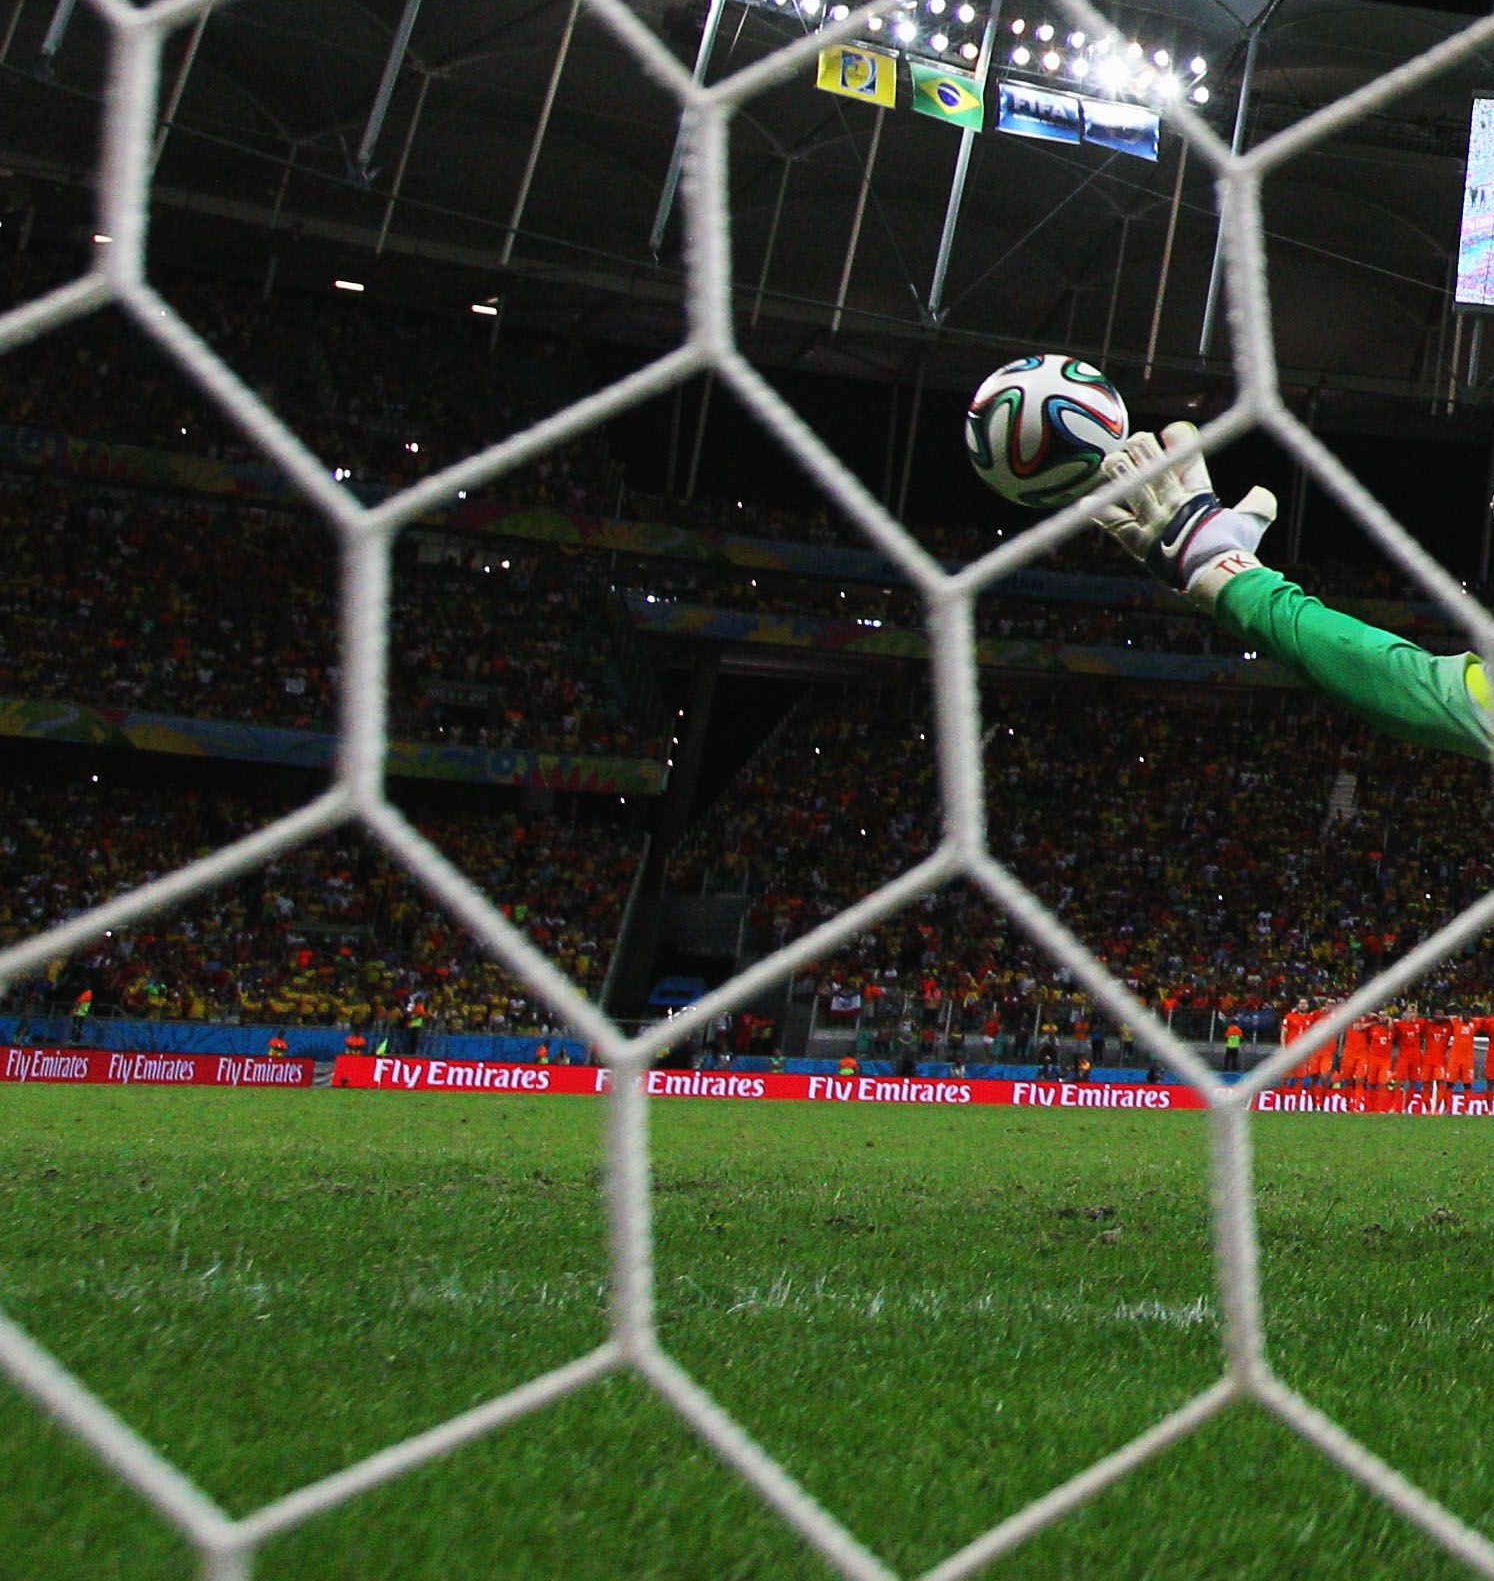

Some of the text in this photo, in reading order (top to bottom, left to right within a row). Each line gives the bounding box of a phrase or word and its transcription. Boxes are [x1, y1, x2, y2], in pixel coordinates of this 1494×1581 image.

[1010, 95, 1069, 118] FIFA
[1214, 553, 1255, 575] TK
[6, 1049, 89, 1082] Fly Emirates
[108, 1053, 195, 1084] Fly Emirates
[216, 1057, 303, 1087] Fly Emirates
[373, 1058, 550, 1090] Fly Emirates
[646, 1070, 766, 1098] Emirates
[807, 1076, 971, 1103] Fly Emirates
[1012, 1082, 1171, 1109] Fly Emirates
